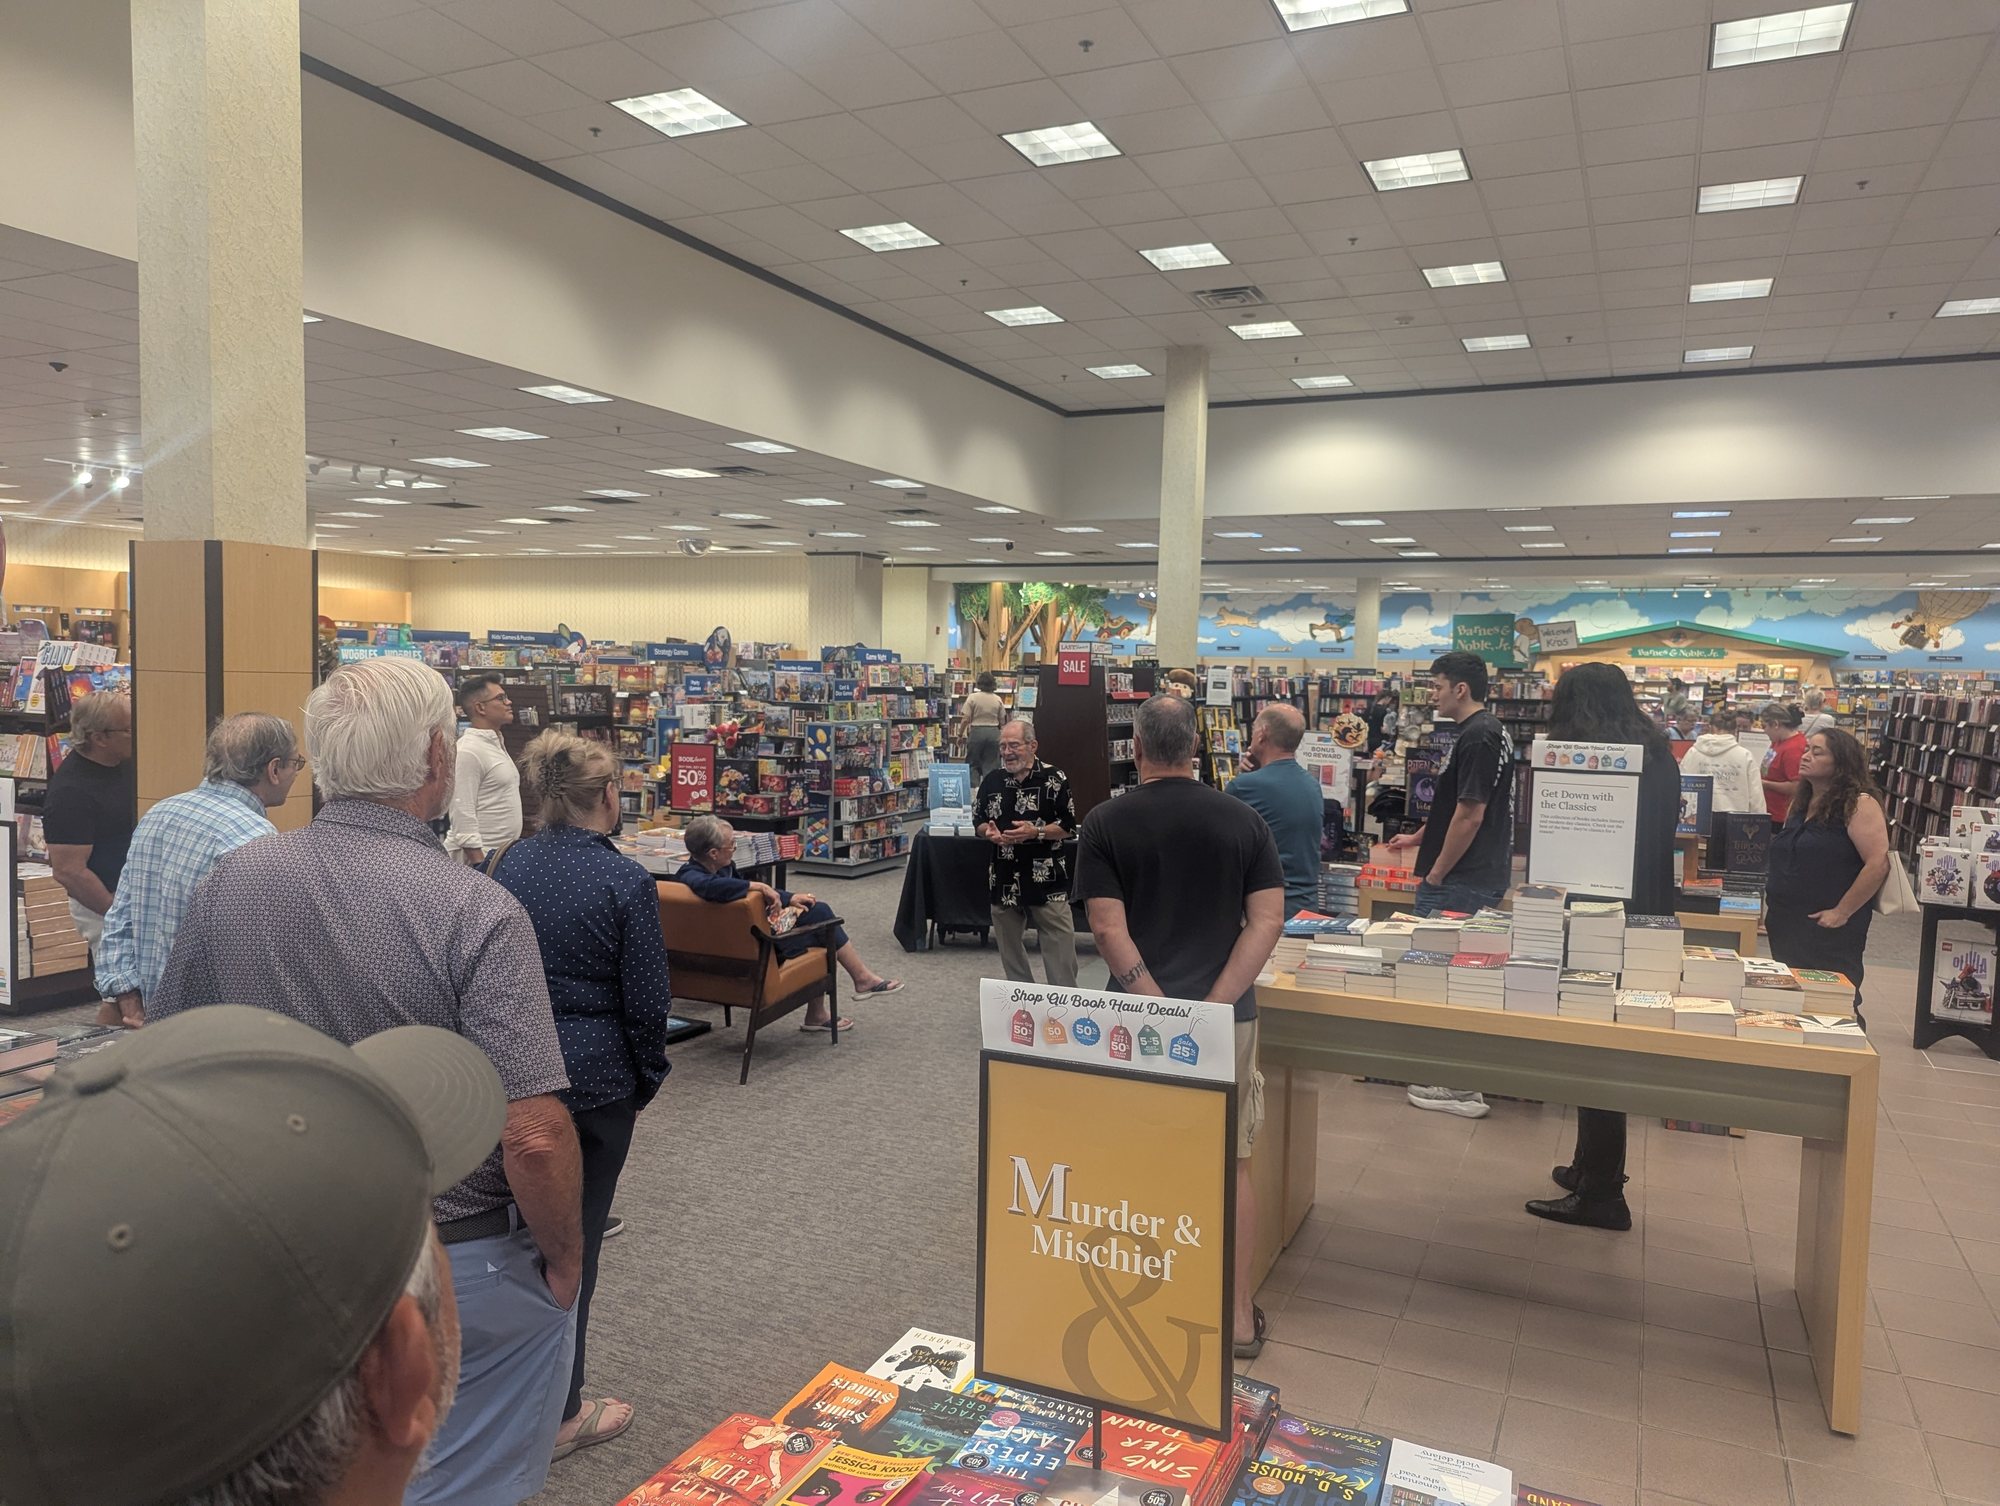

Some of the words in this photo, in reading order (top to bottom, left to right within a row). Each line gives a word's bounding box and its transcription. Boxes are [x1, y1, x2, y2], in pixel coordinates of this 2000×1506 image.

[1456, 625, 1499, 636] Barnes
[1501, 625, 1511, 635] &
[654, 648, 673, 657] Strategy
[673, 648, 689, 656] Games
[1456, 639, 1494, 652] Noble,
[1495, 641, 1511, 650] Jr.
[1637, 648, 1668, 657] Barnes
[1669, 648, 1678, 657] &
[1679, 649, 1707, 658] Noble,
[1707, 649, 1719, 657] Jr.
[40, 645, 74, 666] GIANT
[865, 653, 879, 661] Game
[1063, 659, 1086, 673] SALE
[678, 769, 707, 786] 50%
[1541, 788, 1558, 798] Get
[1561, 790, 1589, 800] Down
[1592, 792, 1614, 802] with
[1540, 800, 1556, 809] the
[1558, 801, 1597, 812] Classics
[1011, 988, 1044, 1005] Shop
[1047, 992, 1068, 1006] All
[1071, 995, 1107, 1009] Book
[1109, 999, 1144, 1013] Haul
[1147, 1002, 1192, 1018] Deals!
[1177, 1037, 1193, 1047] Sale
[1172, 1044, 1196, 1058] 25%
[1007, 1154, 1166, 1240] Murder
[1173, 1214, 1202, 1248] &
[1030, 1224, 1178, 1282] Mischief
[913, 1332, 952, 1345] NORTH
[908, 1354, 956, 1368] WHISPER
[830, 1378, 895, 1404] Sinners
[841, 1396, 862, 1406] and
[944, 1395, 987, 1412] GREY
[812, 1401, 869, 1425] Saints
[930, 1402, 987, 1423] STACIE
[817, 1421, 838, 1431] for
[1120, 1436, 1183, 1456] HER
[1331, 1430, 1382, 1448] Jordan
[730, 1452, 756, 1465] THE
[835, 1450, 851, 1458] NEW
[1420, 1450, 1453, 1462] delany
[1454, 1458, 1480, 1469] vicki
[824, 1462, 848, 1471] AUTHOR
[856, 1469, 883, 1477] LUCKIEST
[828, 1455, 879, 1472] JESSICA
[880, 1465, 921, 1474] KNOLL
[994, 1464, 1030, 1480] THE
[1121, 1454, 1199, 1479] SING
[1433, 1459, 1461, 1470] bestselling
[685, 1455, 767, 1492] IVORY
[1247, 1461, 1306, 1485] HOUSE
[1314, 1478, 1331, 1492] D.
[1339, 1485, 1354, 1501] S.
[1398, 1469, 1421, 1479] read
[1422, 1475, 1440, 1485] she
[931, 1482, 964, 1497] the
[1389, 1473, 1447, 1492] elementary,
[669, 1479, 732, 1506] CITY
